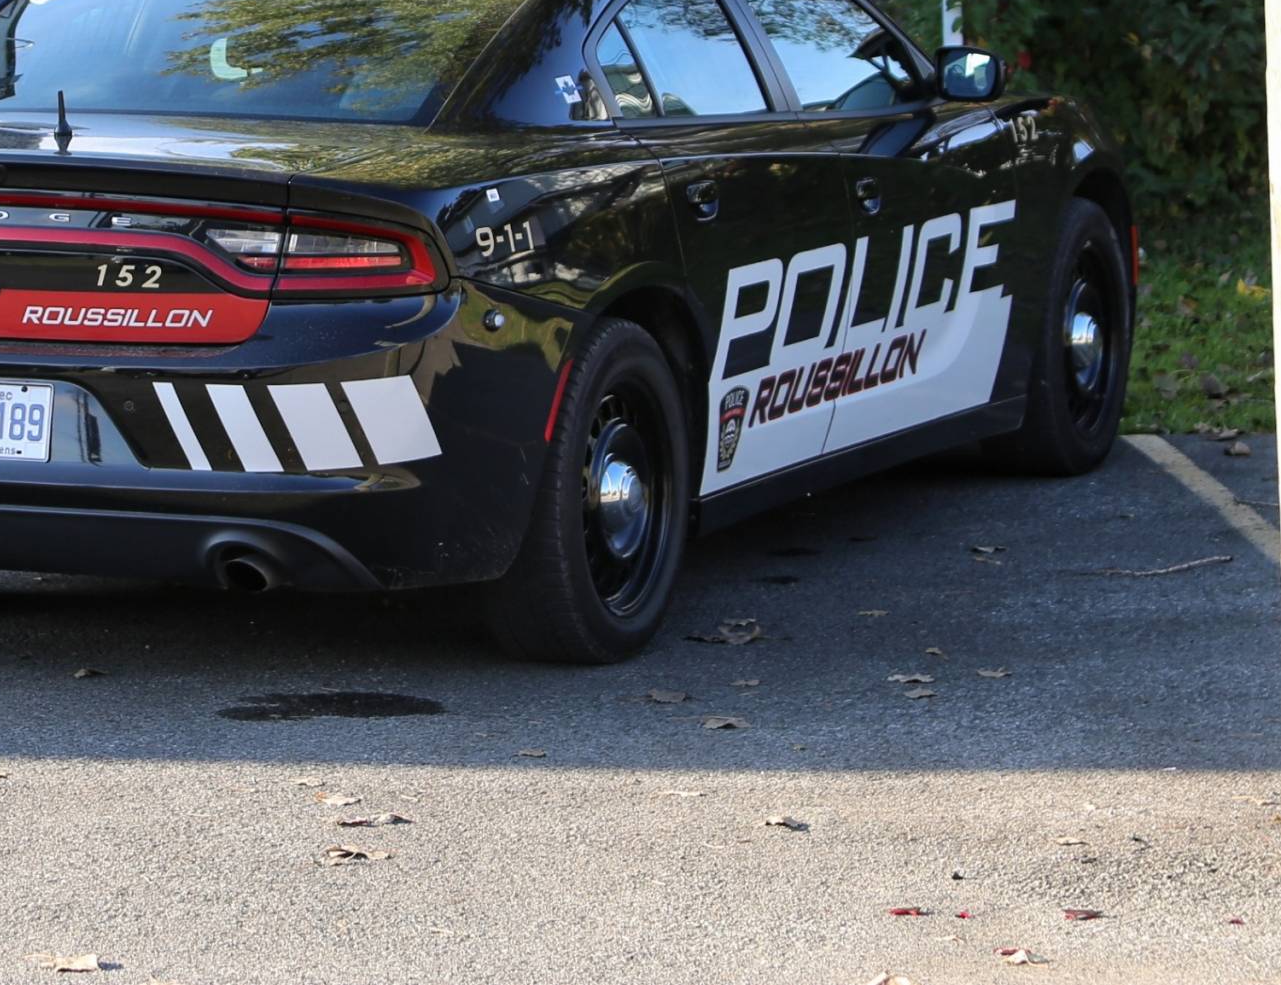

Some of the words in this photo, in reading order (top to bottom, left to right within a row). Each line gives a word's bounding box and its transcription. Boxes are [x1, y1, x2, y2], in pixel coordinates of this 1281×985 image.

[1007, 115, 1040, 143] 152
[475, 220, 535, 257] 9-1-1
[96, 263, 163, 289] 152
[710, 199, 1017, 382] POLICE
[21, 305, 213, 328] ROUSSILLON
[747, 328, 928, 429] ROUSSILLON
[724, 389, 745, 411] POLICE
